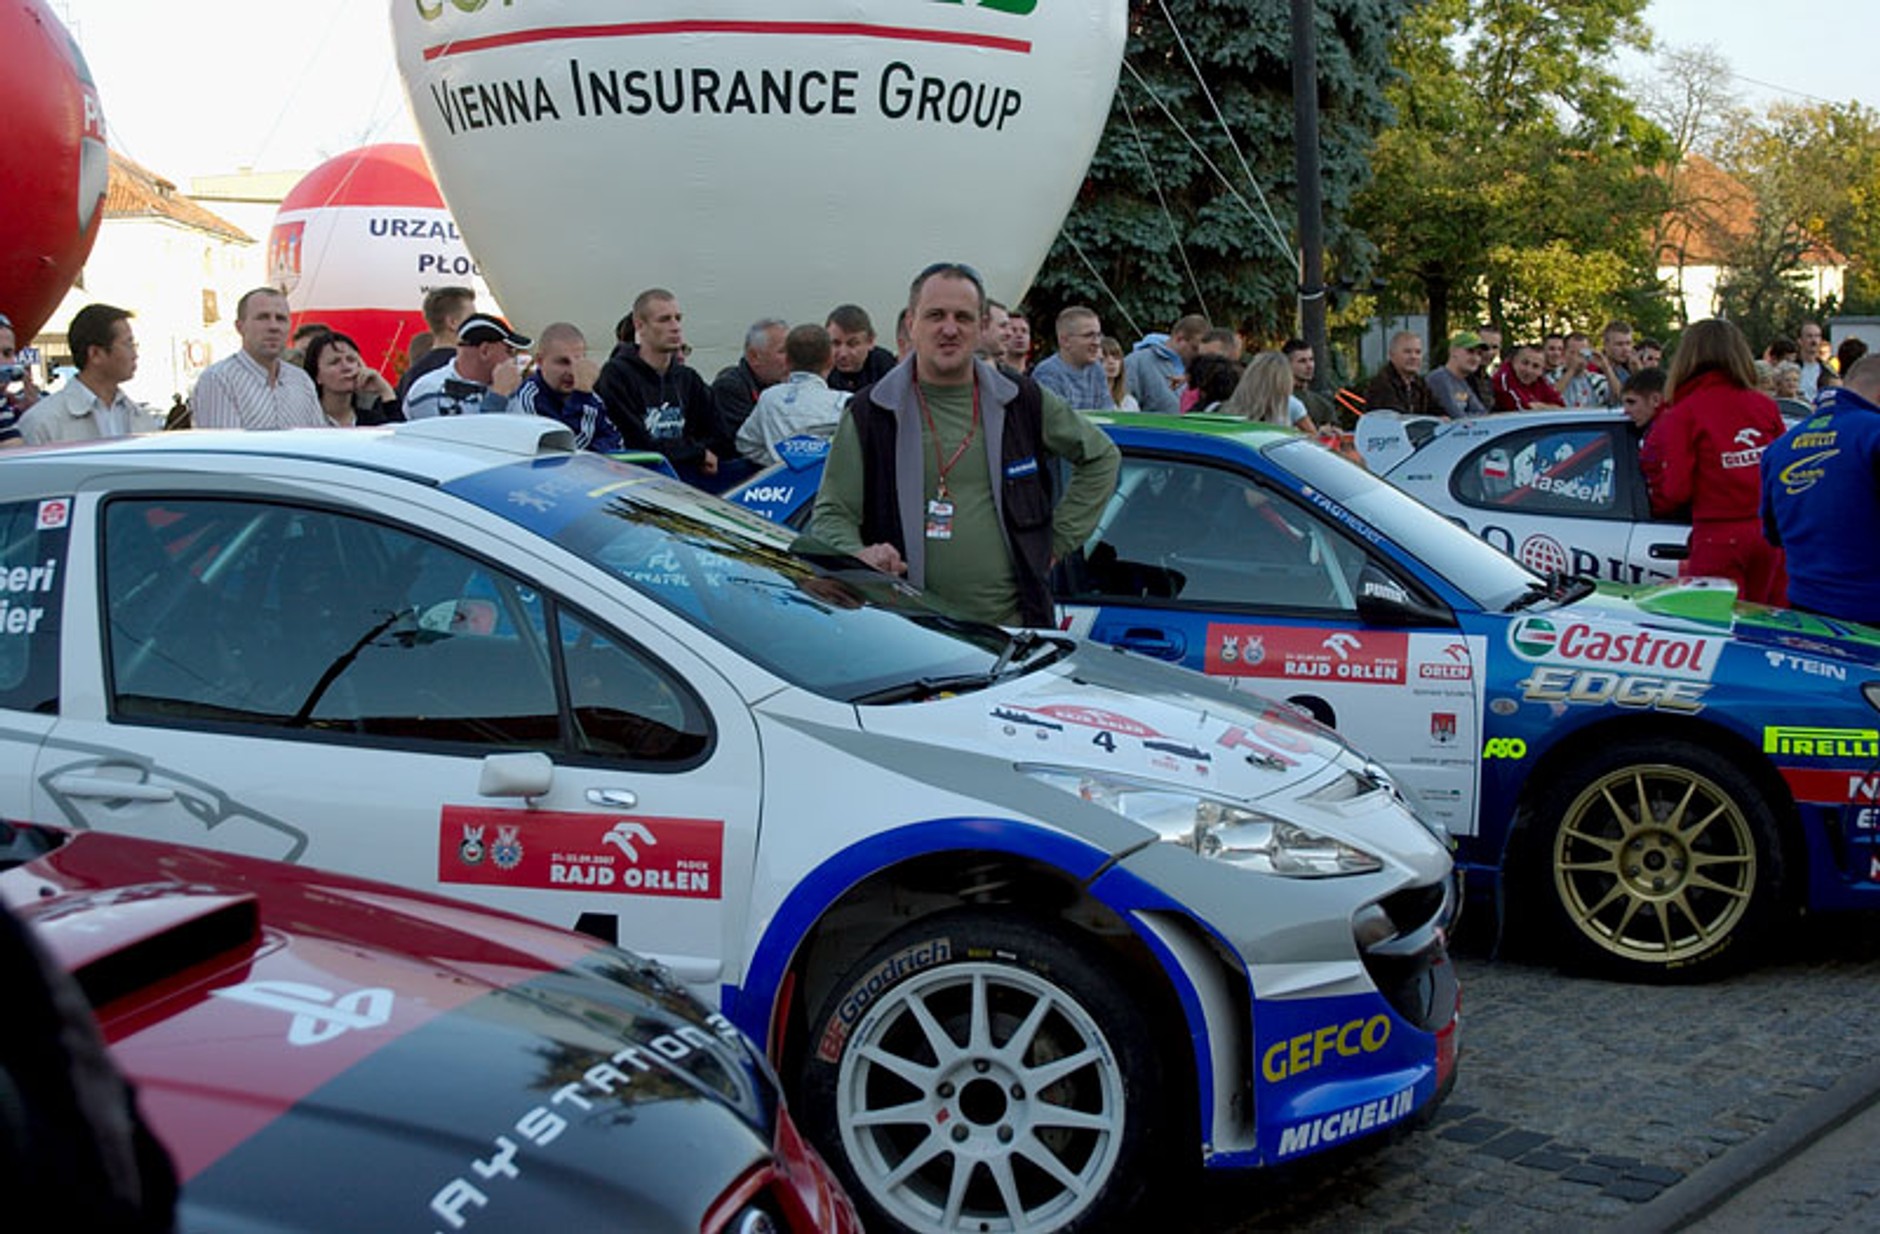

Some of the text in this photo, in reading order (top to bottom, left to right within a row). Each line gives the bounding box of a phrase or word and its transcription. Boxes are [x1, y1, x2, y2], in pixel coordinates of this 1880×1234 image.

[1722, 449, 1764, 469] ORLE
[1559, 624, 1706, 671] Castrol
[1285, 661, 1397, 680] RAJD ORLEN
[1421, 664, 1470, 680] ORLEN
[1516, 666, 1713, 716] EDGE
[1092, 731, 1117, 753] 4
[1764, 726, 1879, 758] PIRELLI
[550, 864, 709, 892] RAJD ORLEN
[1262, 1014, 1392, 1083] GEFCO
[1278, 1087, 1414, 1156] MICHELIN
